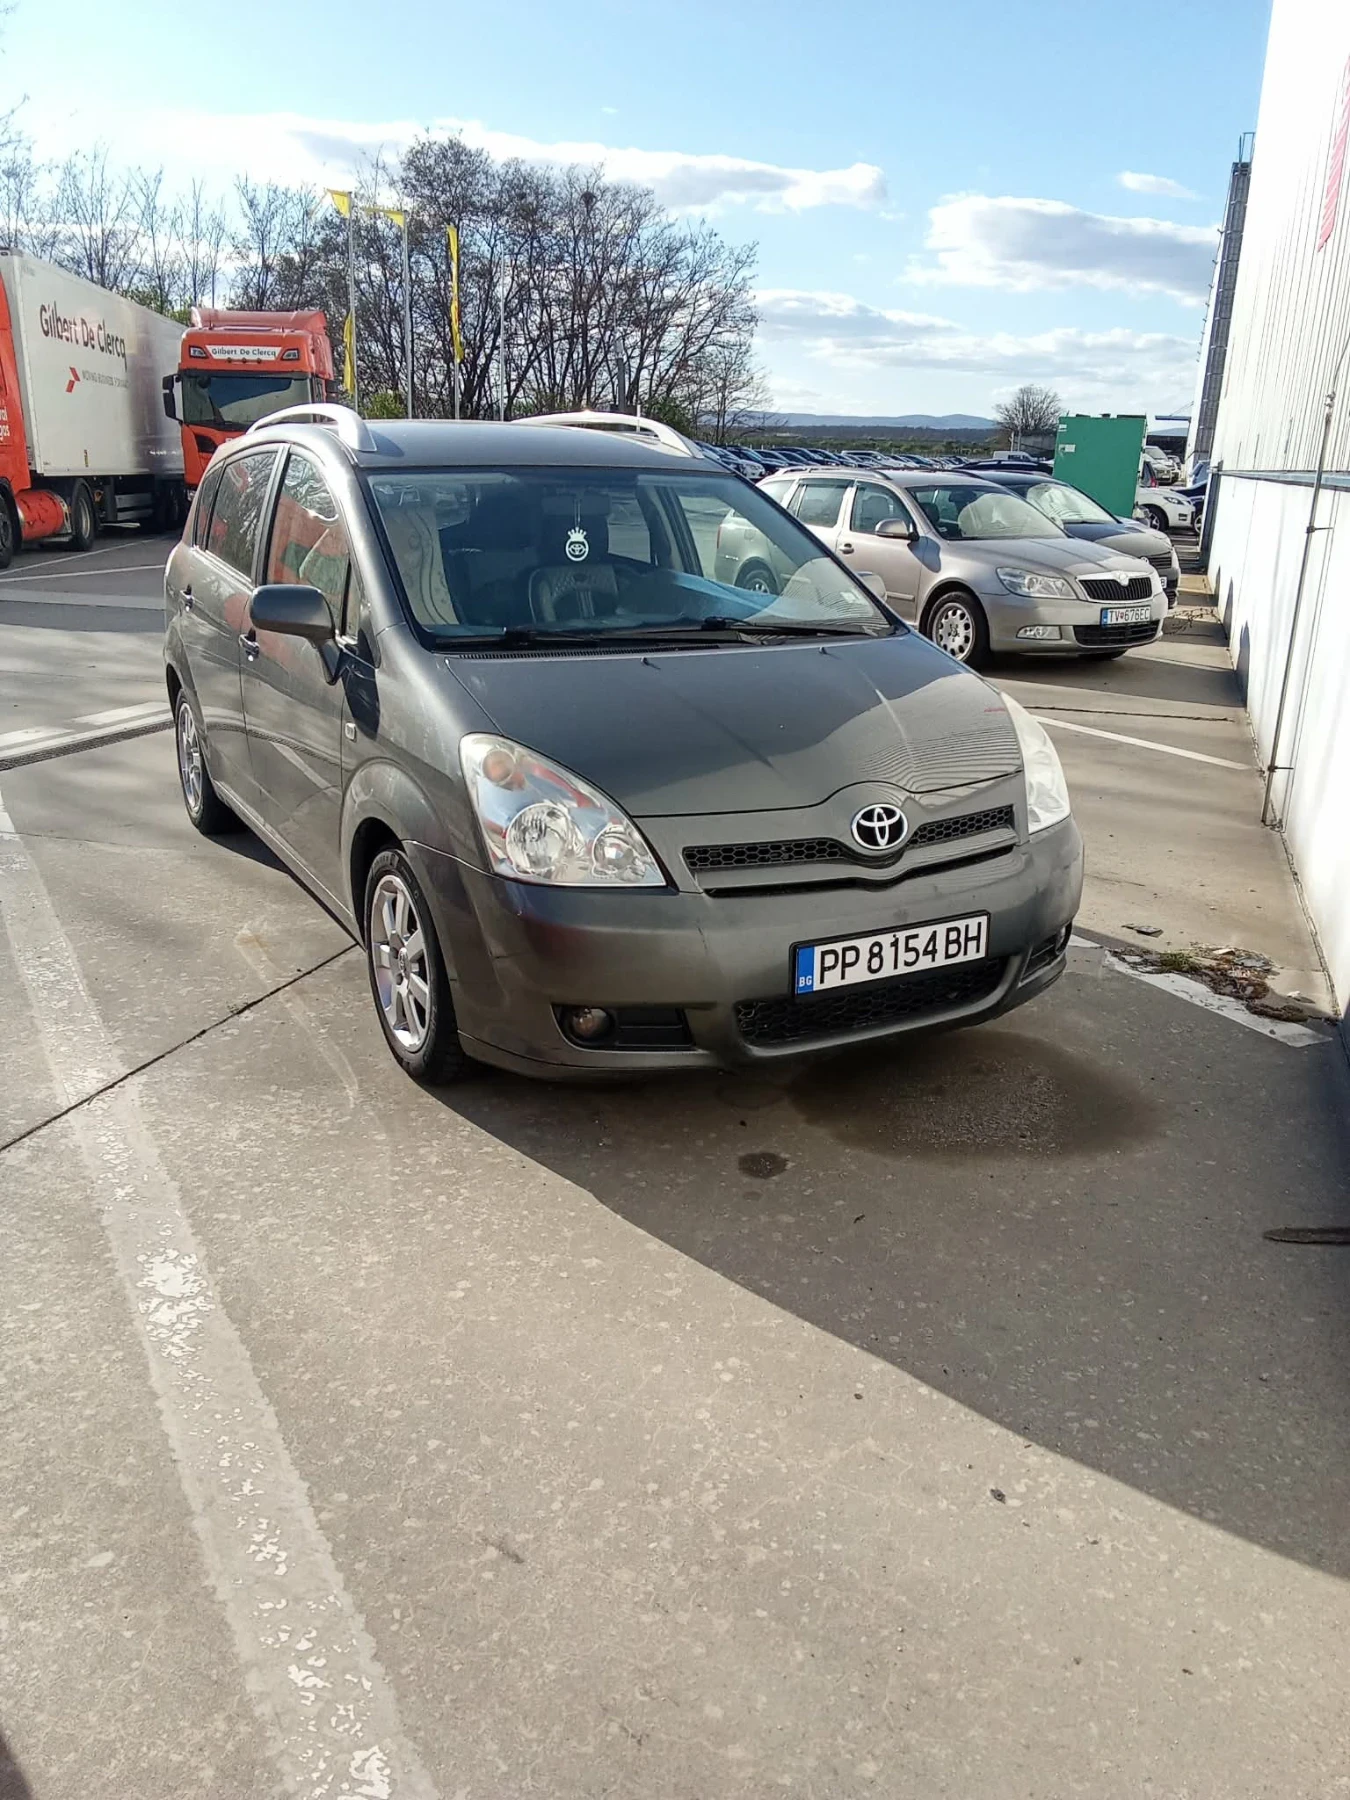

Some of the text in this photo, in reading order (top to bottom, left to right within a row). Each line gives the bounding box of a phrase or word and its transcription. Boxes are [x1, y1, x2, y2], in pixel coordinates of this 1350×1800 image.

[40, 300, 128, 373] Gilbert De Clercq
[212, 347, 237, 355] Gilbert
[252, 348, 277, 357] Clercq
[819, 921, 982, 984] PP 8154 BH
[799, 975, 813, 988] BG
